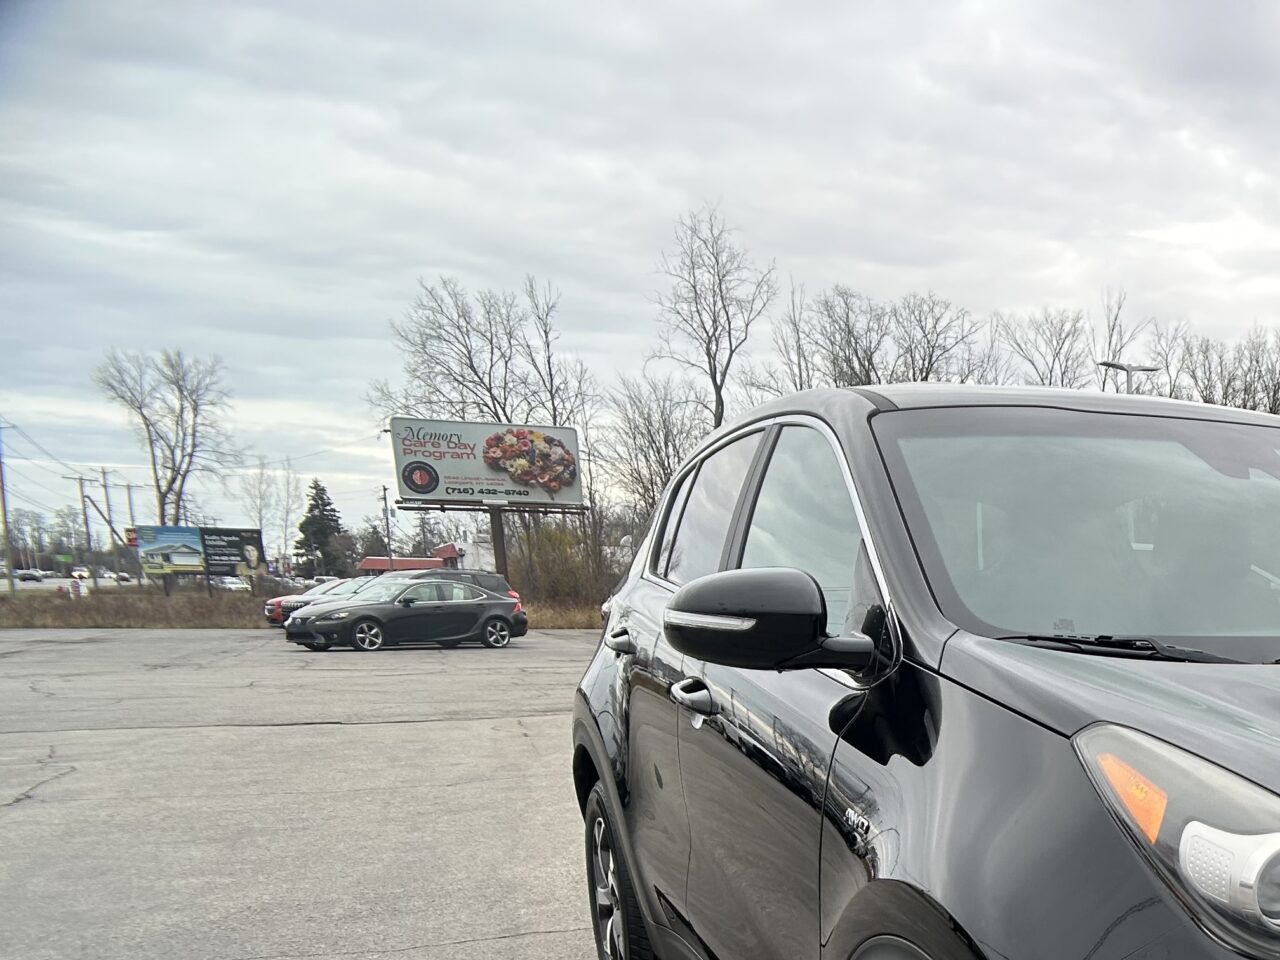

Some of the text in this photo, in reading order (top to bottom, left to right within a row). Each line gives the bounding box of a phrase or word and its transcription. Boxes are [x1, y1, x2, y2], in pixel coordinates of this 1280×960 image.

[397, 427, 462, 443] Memory
[402, 439, 476, 453] Care Day
[403, 448, 476, 460] Program
[445, 487, 474, 495] (716)
[844, 808, 869, 833] AWD
